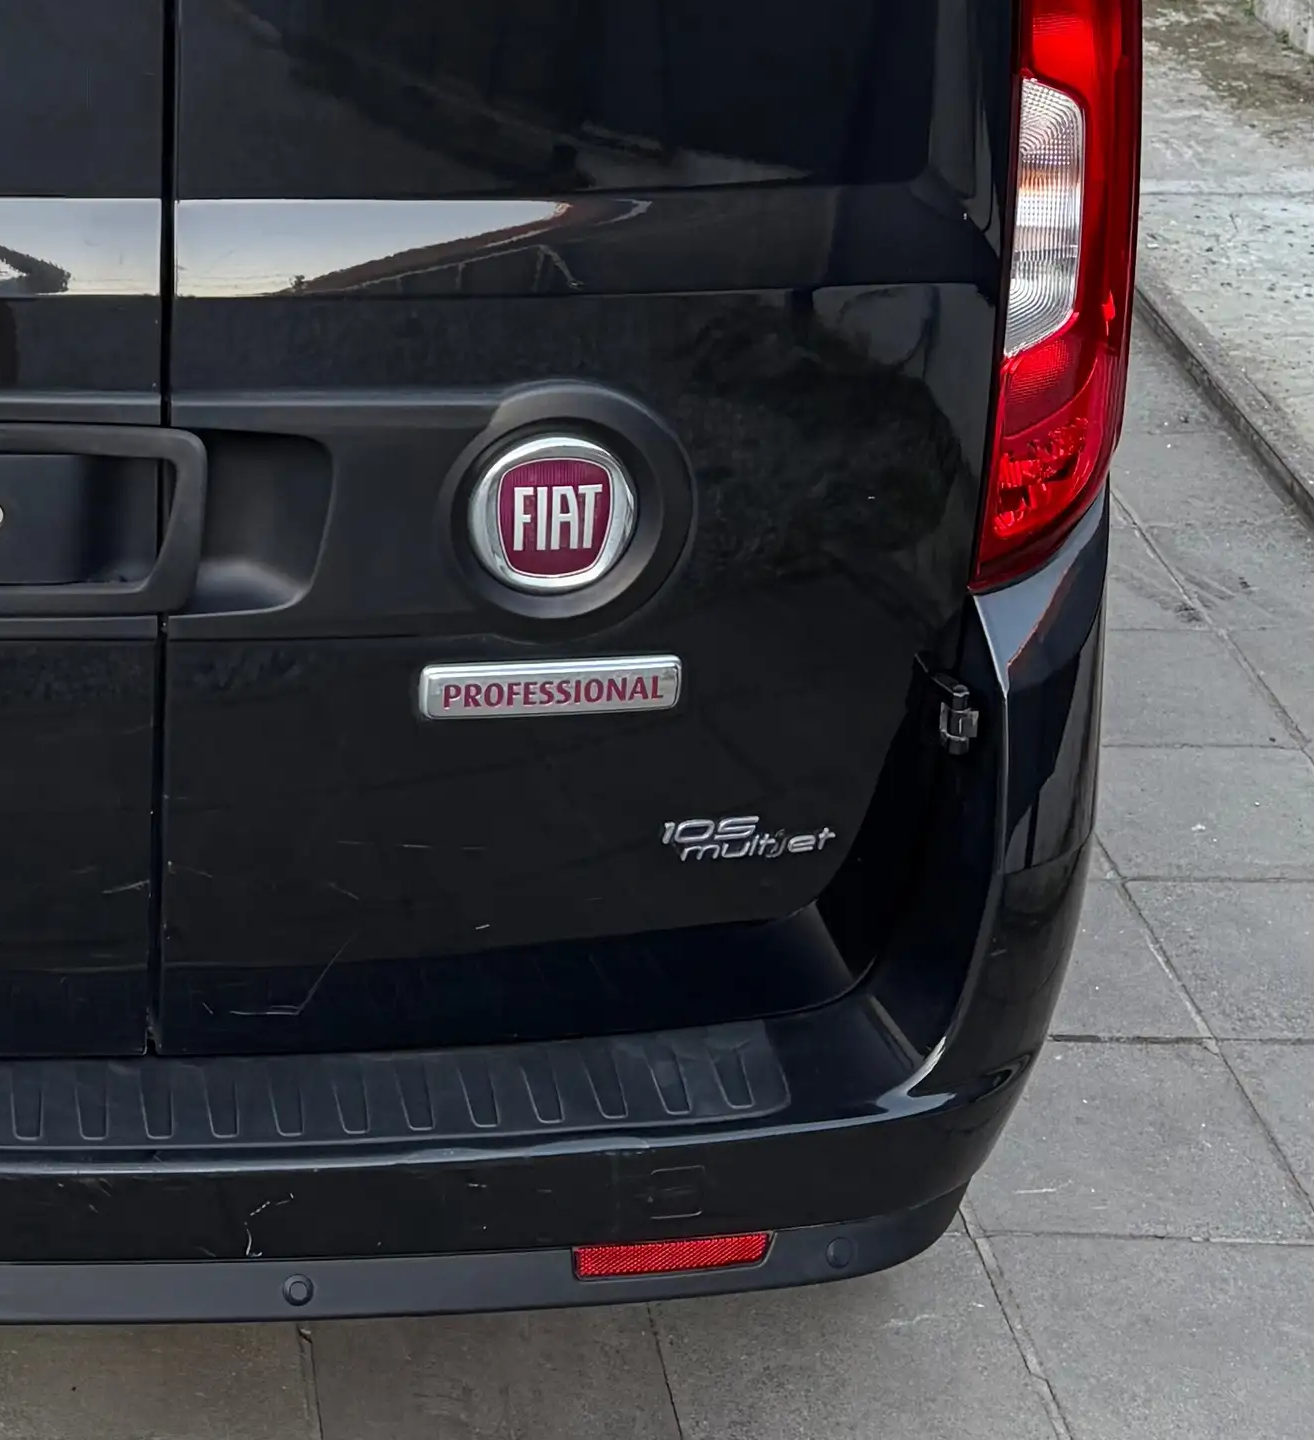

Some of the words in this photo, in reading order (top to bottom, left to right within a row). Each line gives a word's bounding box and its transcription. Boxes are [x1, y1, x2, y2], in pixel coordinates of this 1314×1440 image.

[513, 483, 603, 551] FIAT
[442, 675, 664, 709] PROFESSIONAL
[662, 816, 759, 844] 105
[680, 827, 835, 861] multijet
